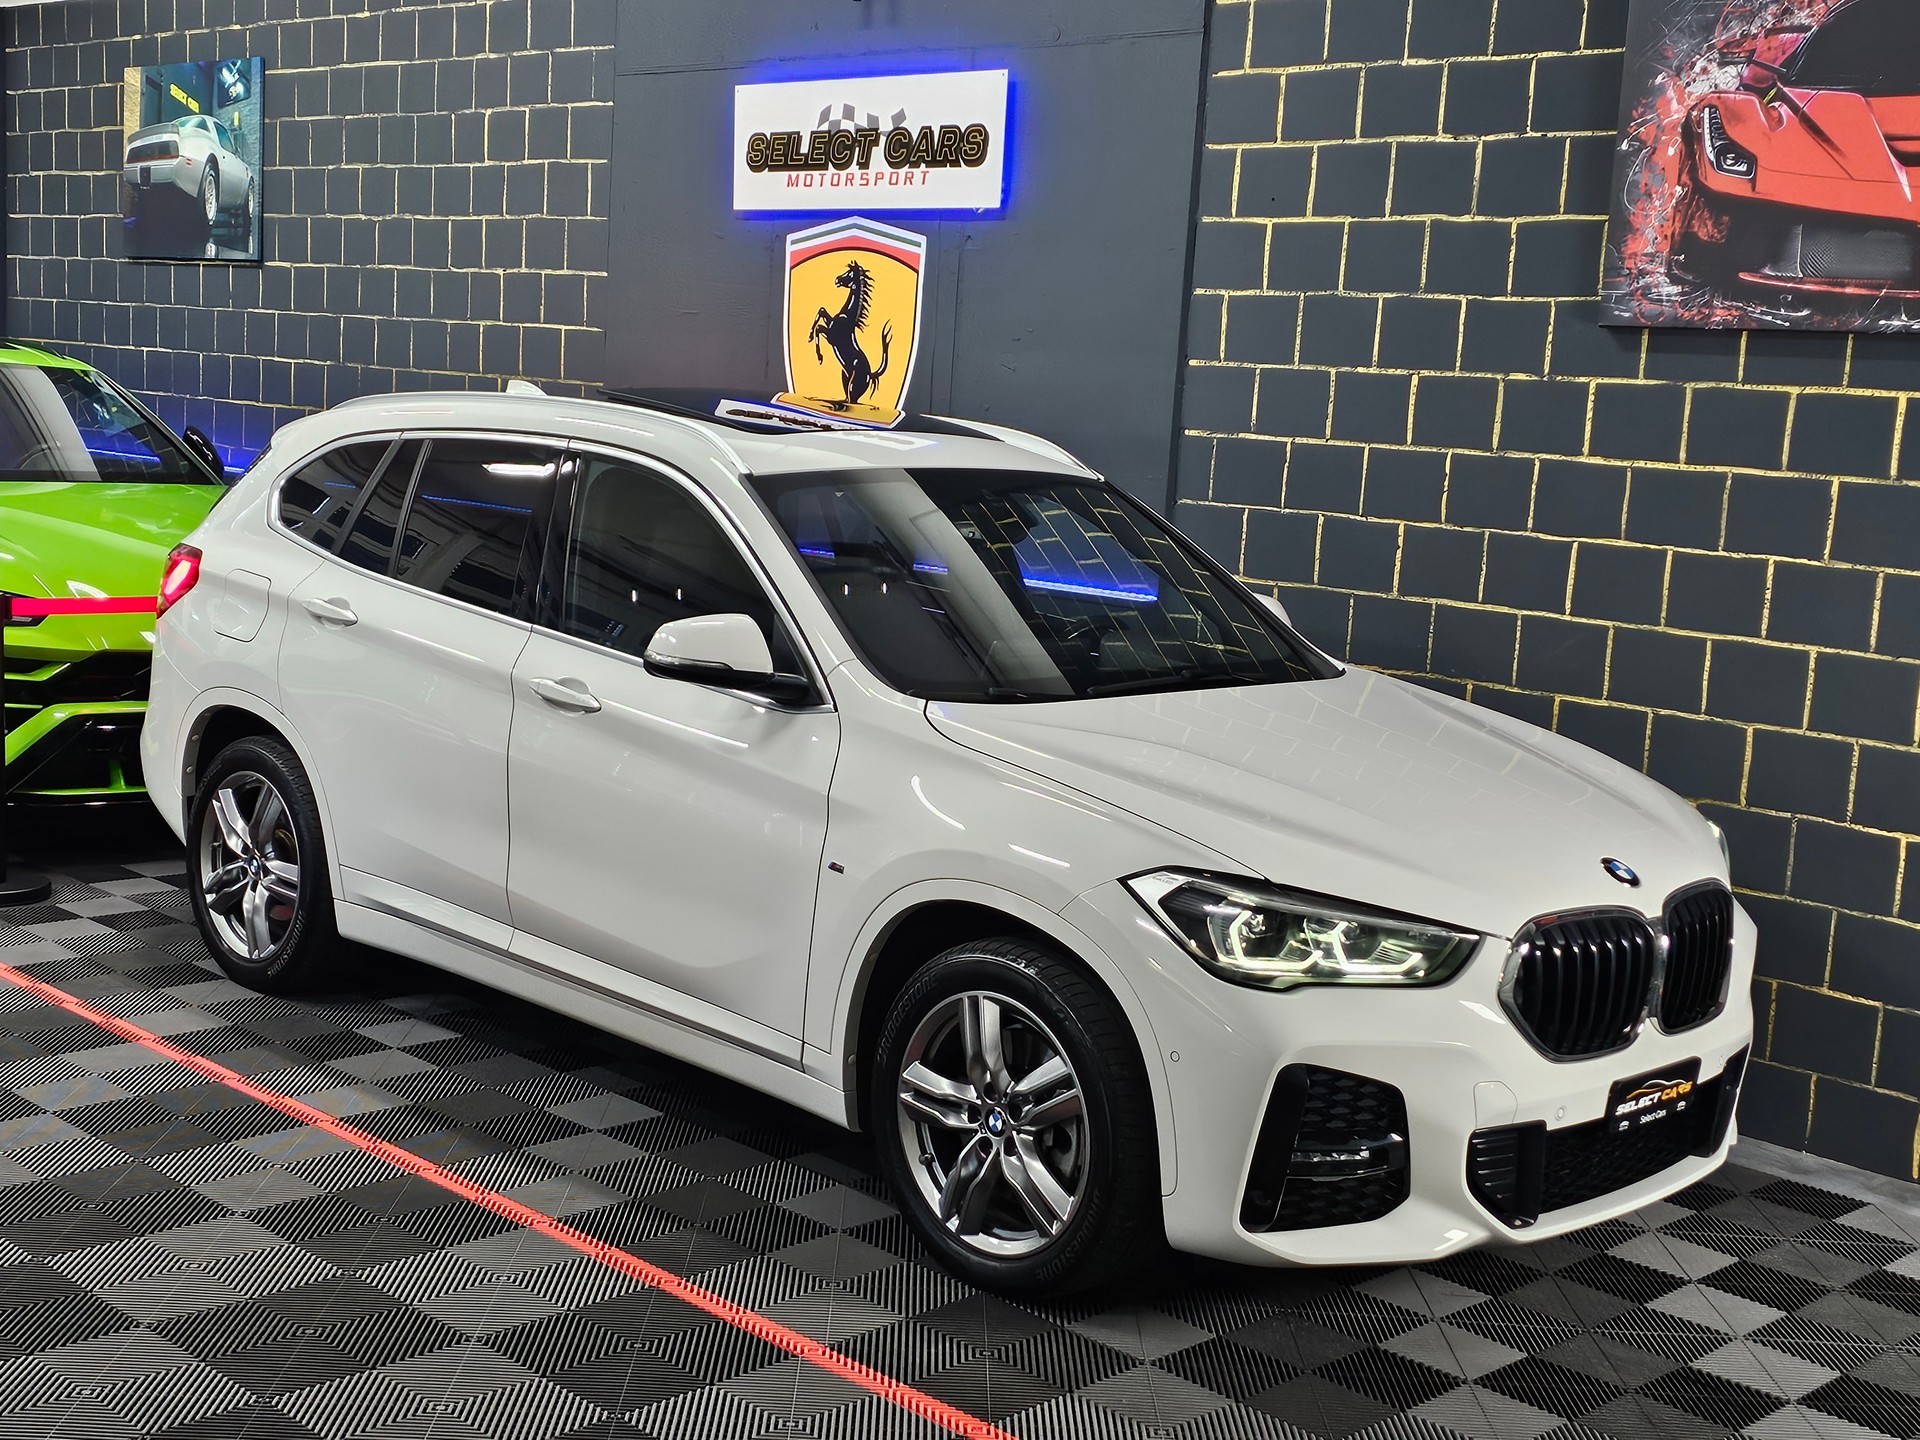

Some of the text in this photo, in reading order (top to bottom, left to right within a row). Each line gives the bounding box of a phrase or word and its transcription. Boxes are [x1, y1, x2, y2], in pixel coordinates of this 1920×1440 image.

[746, 123, 990, 173] SELECT CARS
[787, 171, 930, 188] MOTORSPORT
[1616, 1081, 1692, 1115] SELECT CARS
